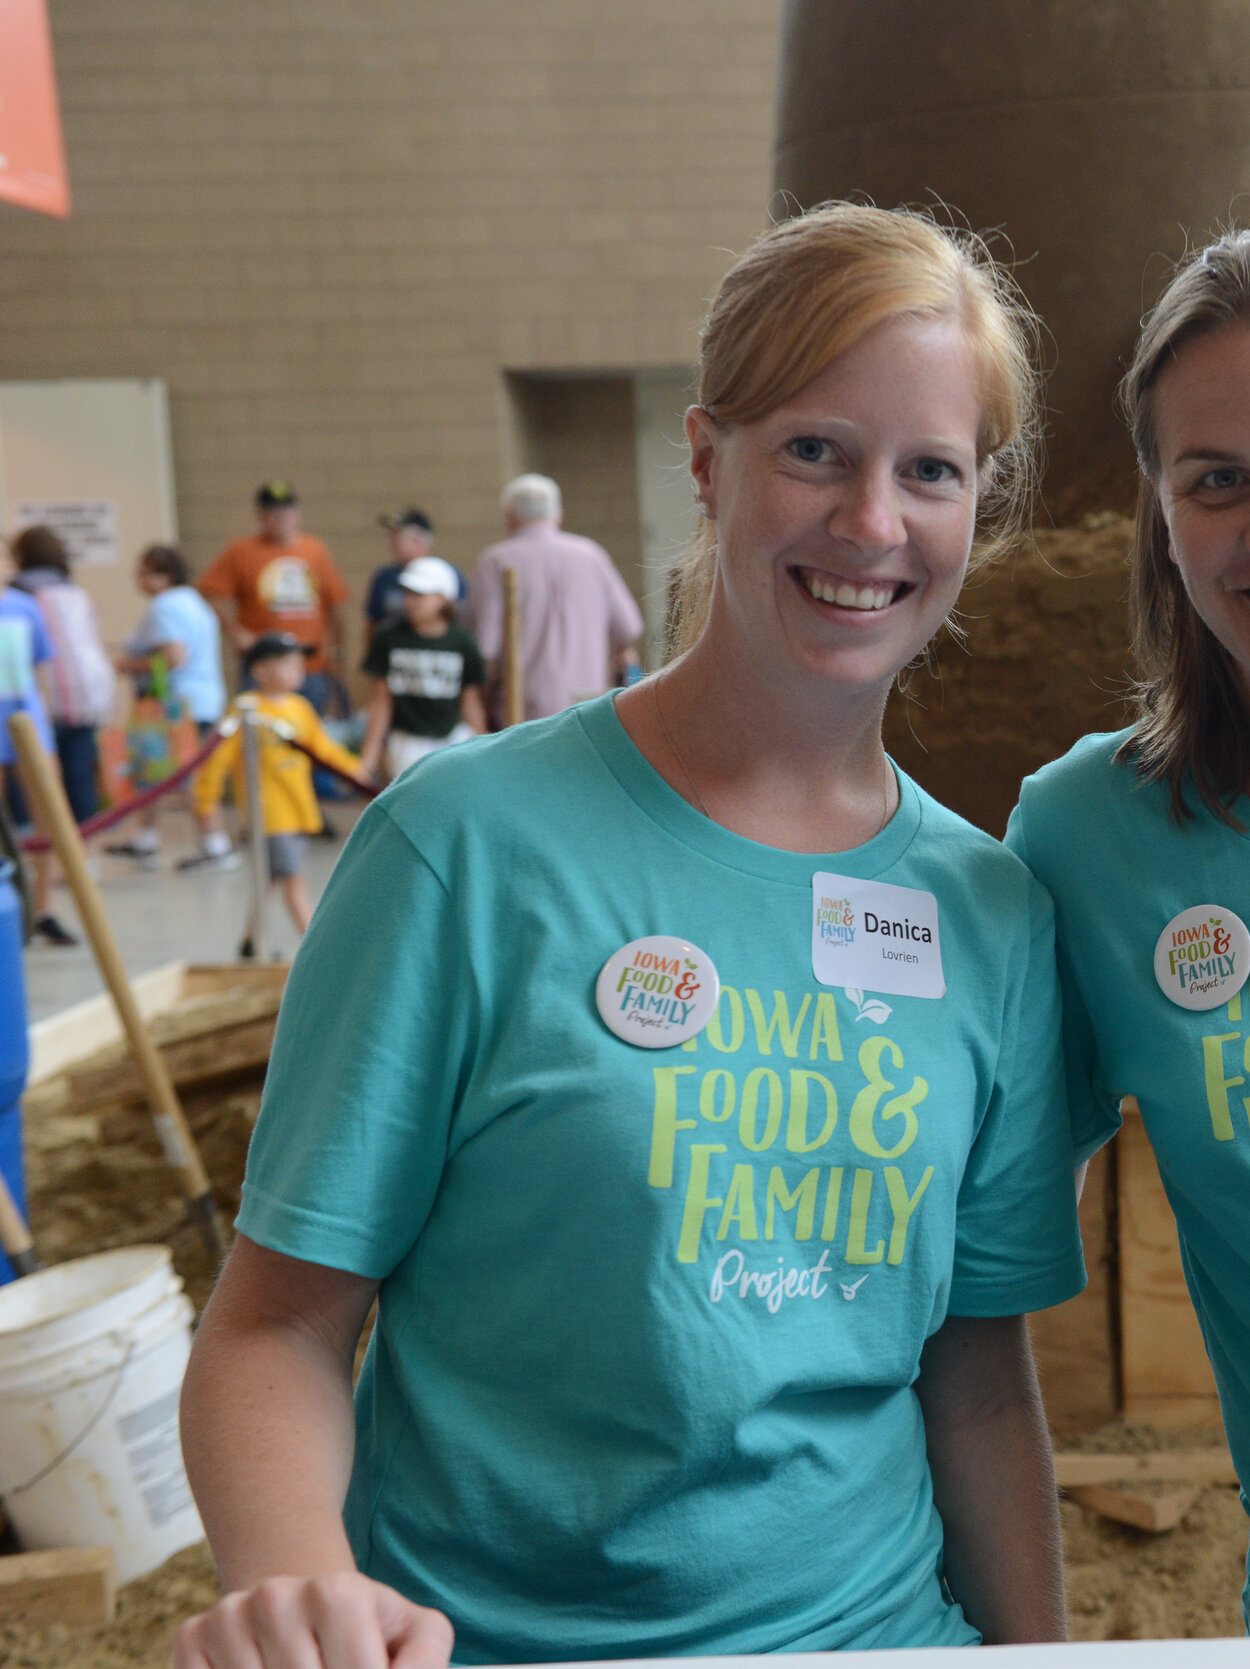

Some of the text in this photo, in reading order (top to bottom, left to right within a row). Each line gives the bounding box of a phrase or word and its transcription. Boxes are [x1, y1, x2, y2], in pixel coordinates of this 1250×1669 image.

[821, 896, 843, 911] IOWA
[842, 907, 855, 927] &
[820, 920, 856, 943] FAMILY
[864, 911, 932, 943] Danica
[1172, 923, 1211, 947] IOWA
[633, 950, 681, 976] IOWA
[882, 947, 919, 964] Lovrien
[1168, 927, 1231, 976] FOOD &
[616, 967, 700, 1000] FOOD &
[1178, 951, 1235, 988] FAMILY
[1189, 976, 1219, 994] Project
[620, 985, 696, 1026] FAMILY
[626, 1010, 664, 1028] Project
[681, 985, 844, 1061] OWA
[648, 1036, 929, 1188] FOOD &
[676, 1144, 935, 1266] FAMILY
[709, 1249, 832, 1314] Project
